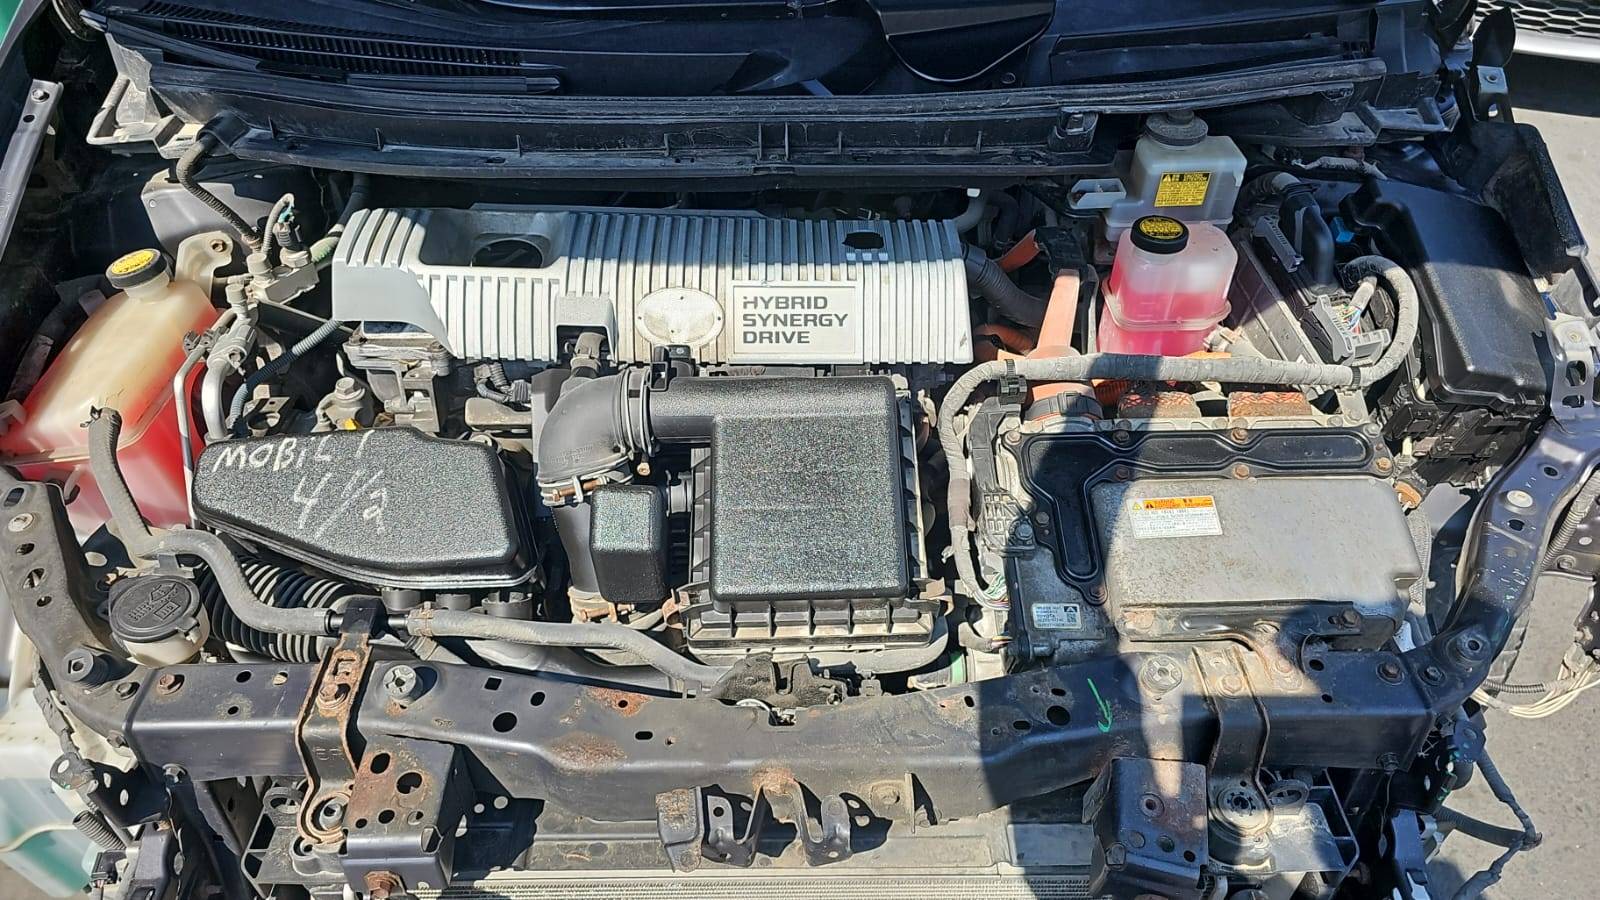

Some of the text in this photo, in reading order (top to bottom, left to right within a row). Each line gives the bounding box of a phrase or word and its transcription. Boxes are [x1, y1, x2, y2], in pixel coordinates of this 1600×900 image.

[743, 296, 828, 310] HYBRID
[742, 313, 848, 327] SYNERGY
[743, 330, 811, 344] DRIVE
[294, 472, 333, 530] 4
